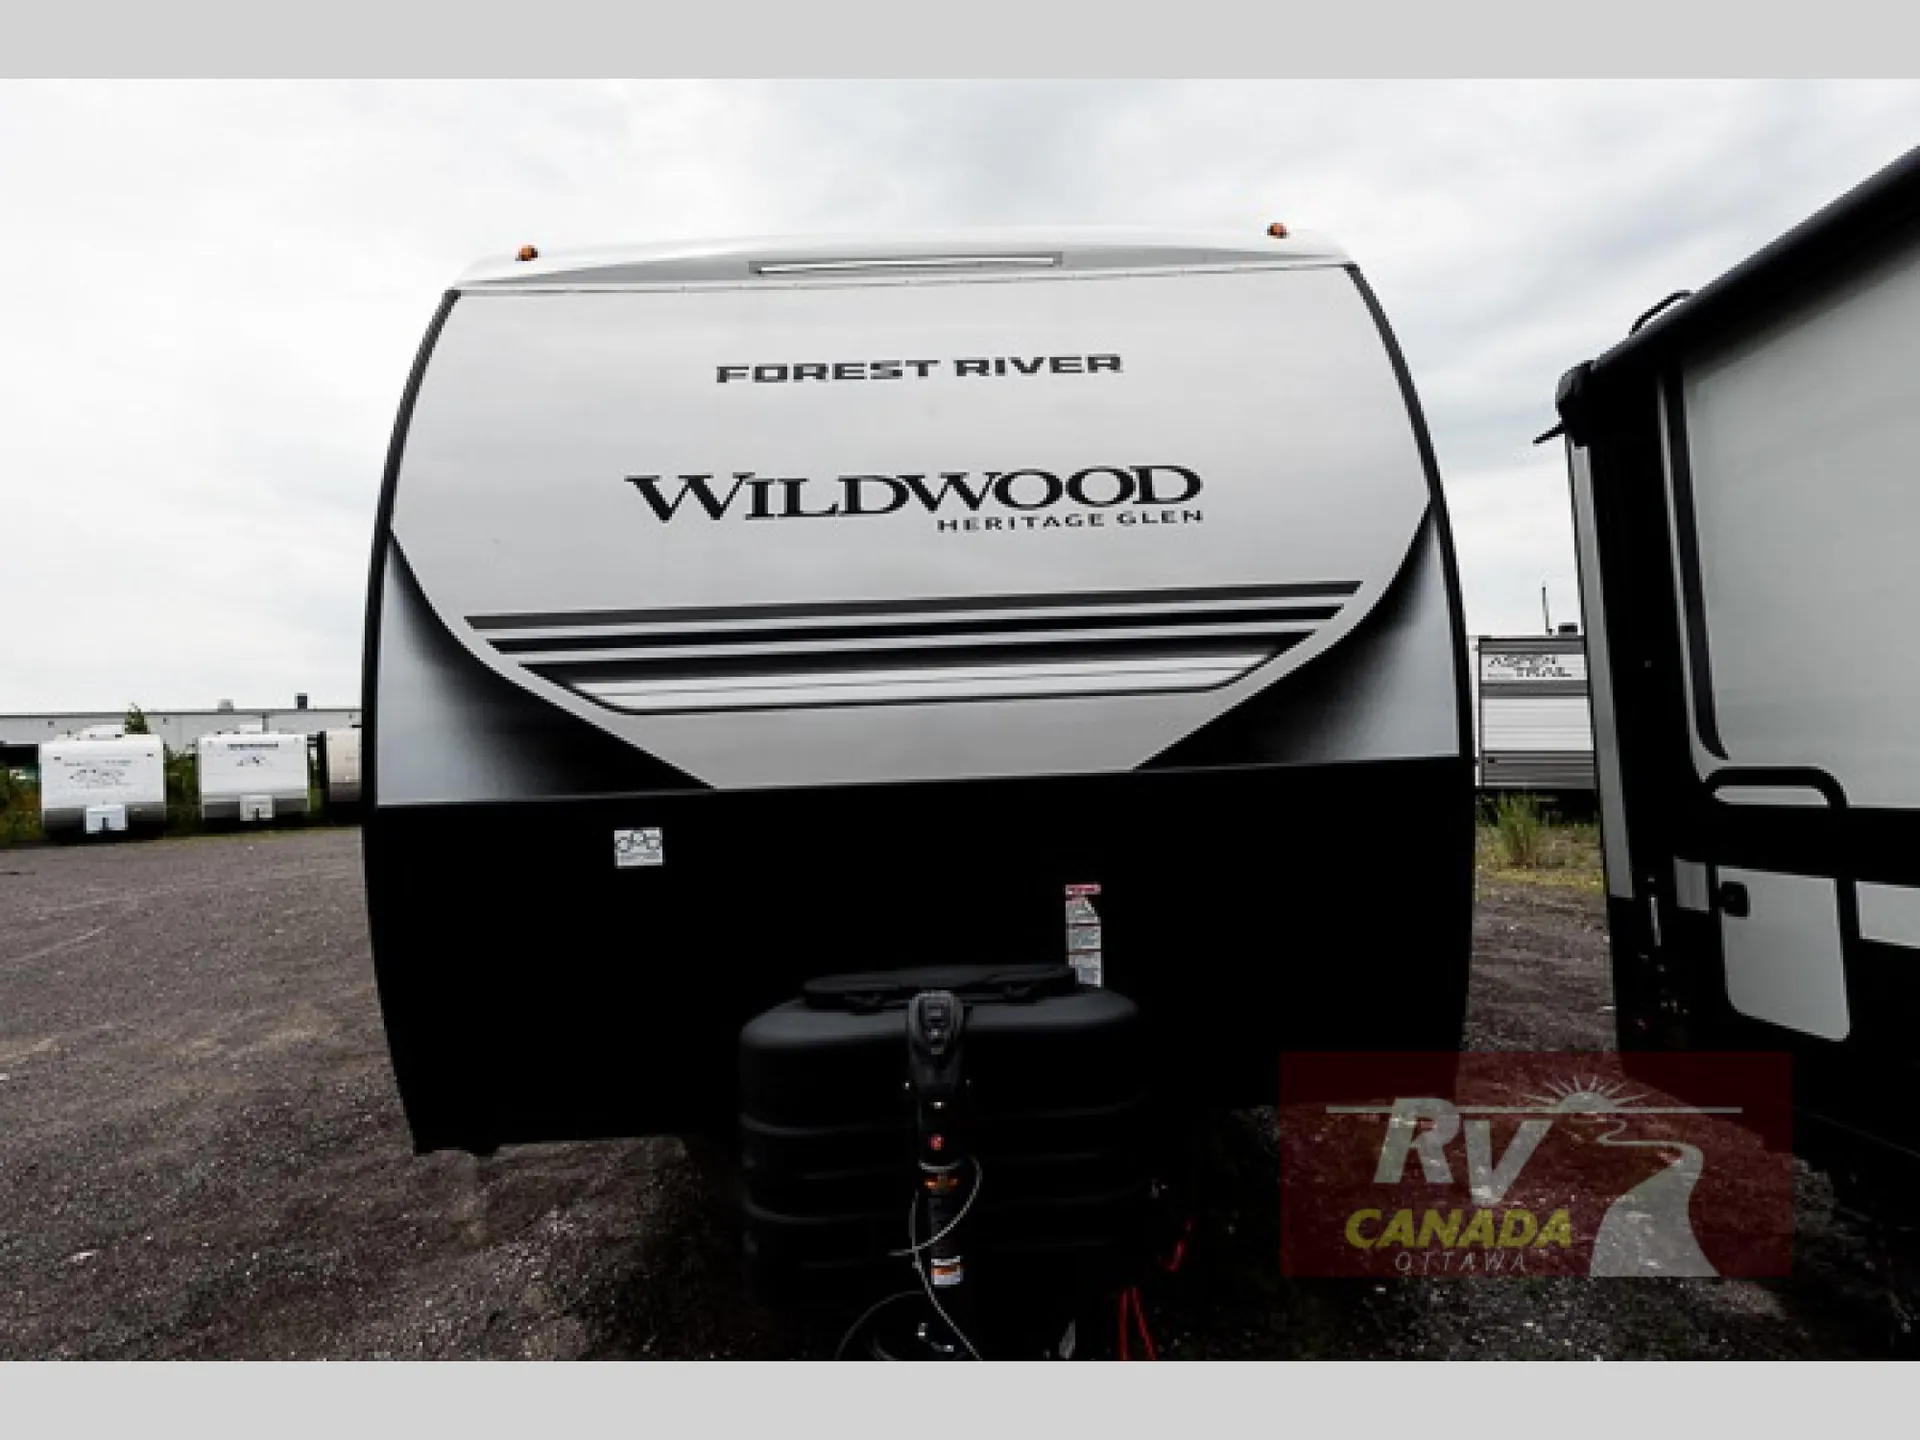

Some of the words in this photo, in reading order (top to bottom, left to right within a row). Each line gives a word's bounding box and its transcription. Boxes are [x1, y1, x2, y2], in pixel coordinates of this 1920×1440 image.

[716, 358, 941, 384] FOREST
[953, 353, 1123, 377] RIVER
[624, 465, 1203, 522] WILDWOOD
[937, 514, 1105, 532] HERITAGE
[1116, 509, 1204, 527] GLEN
